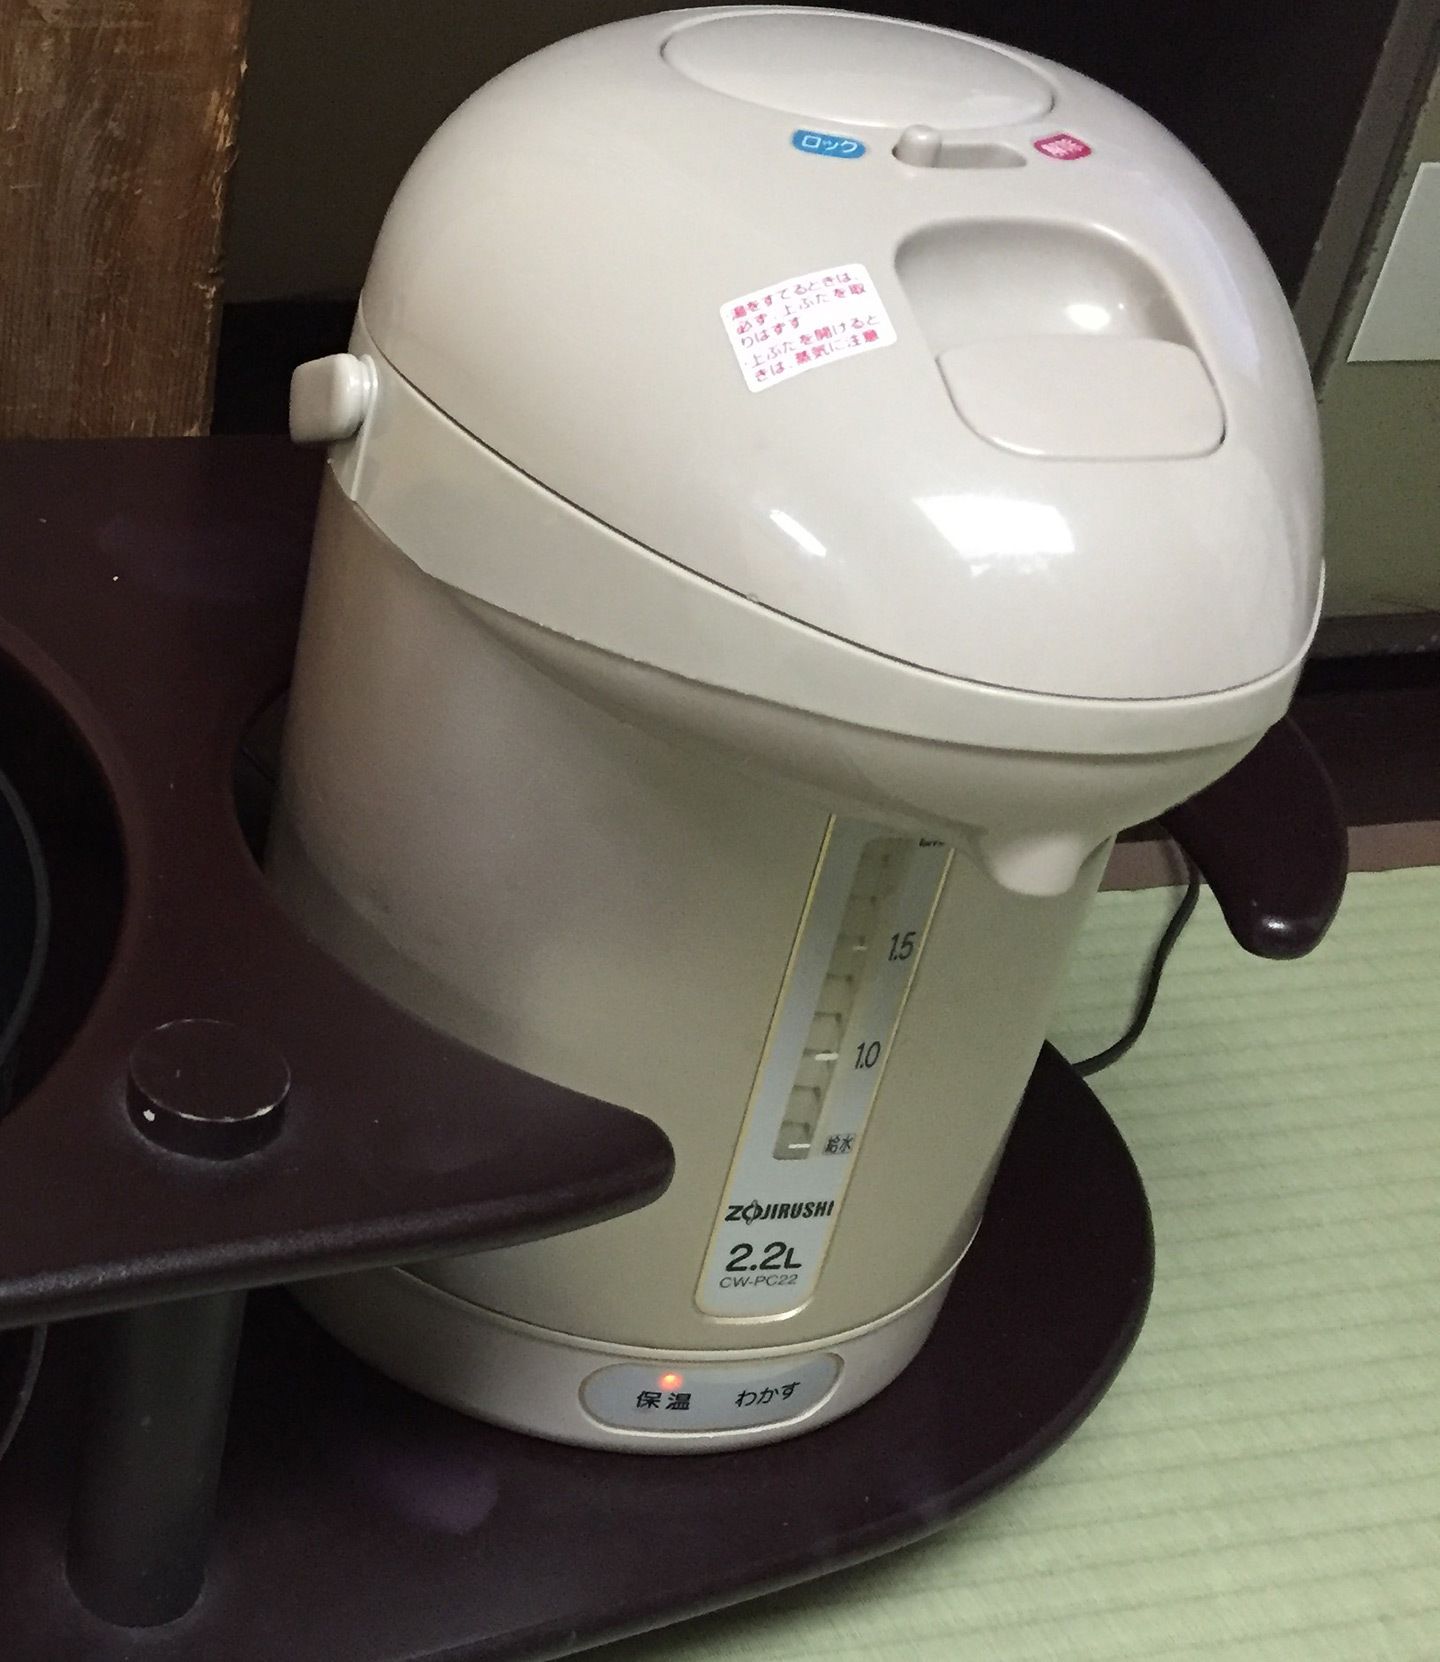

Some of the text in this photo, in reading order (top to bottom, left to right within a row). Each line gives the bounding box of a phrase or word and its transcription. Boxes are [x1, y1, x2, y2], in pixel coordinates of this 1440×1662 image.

[801, 134, 858, 154] ロック
[888, 931, 916, 961] 1.5
[855, 1041, 881, 1069] 1.0
[725, 1200, 835, 1224] ZOJIRUSHI
[725, 1241, 802, 1272] 2.2L
[719, 1274, 799, 1289] CW-PC22
[636, 1381, 801, 1411] 保温 わかす
